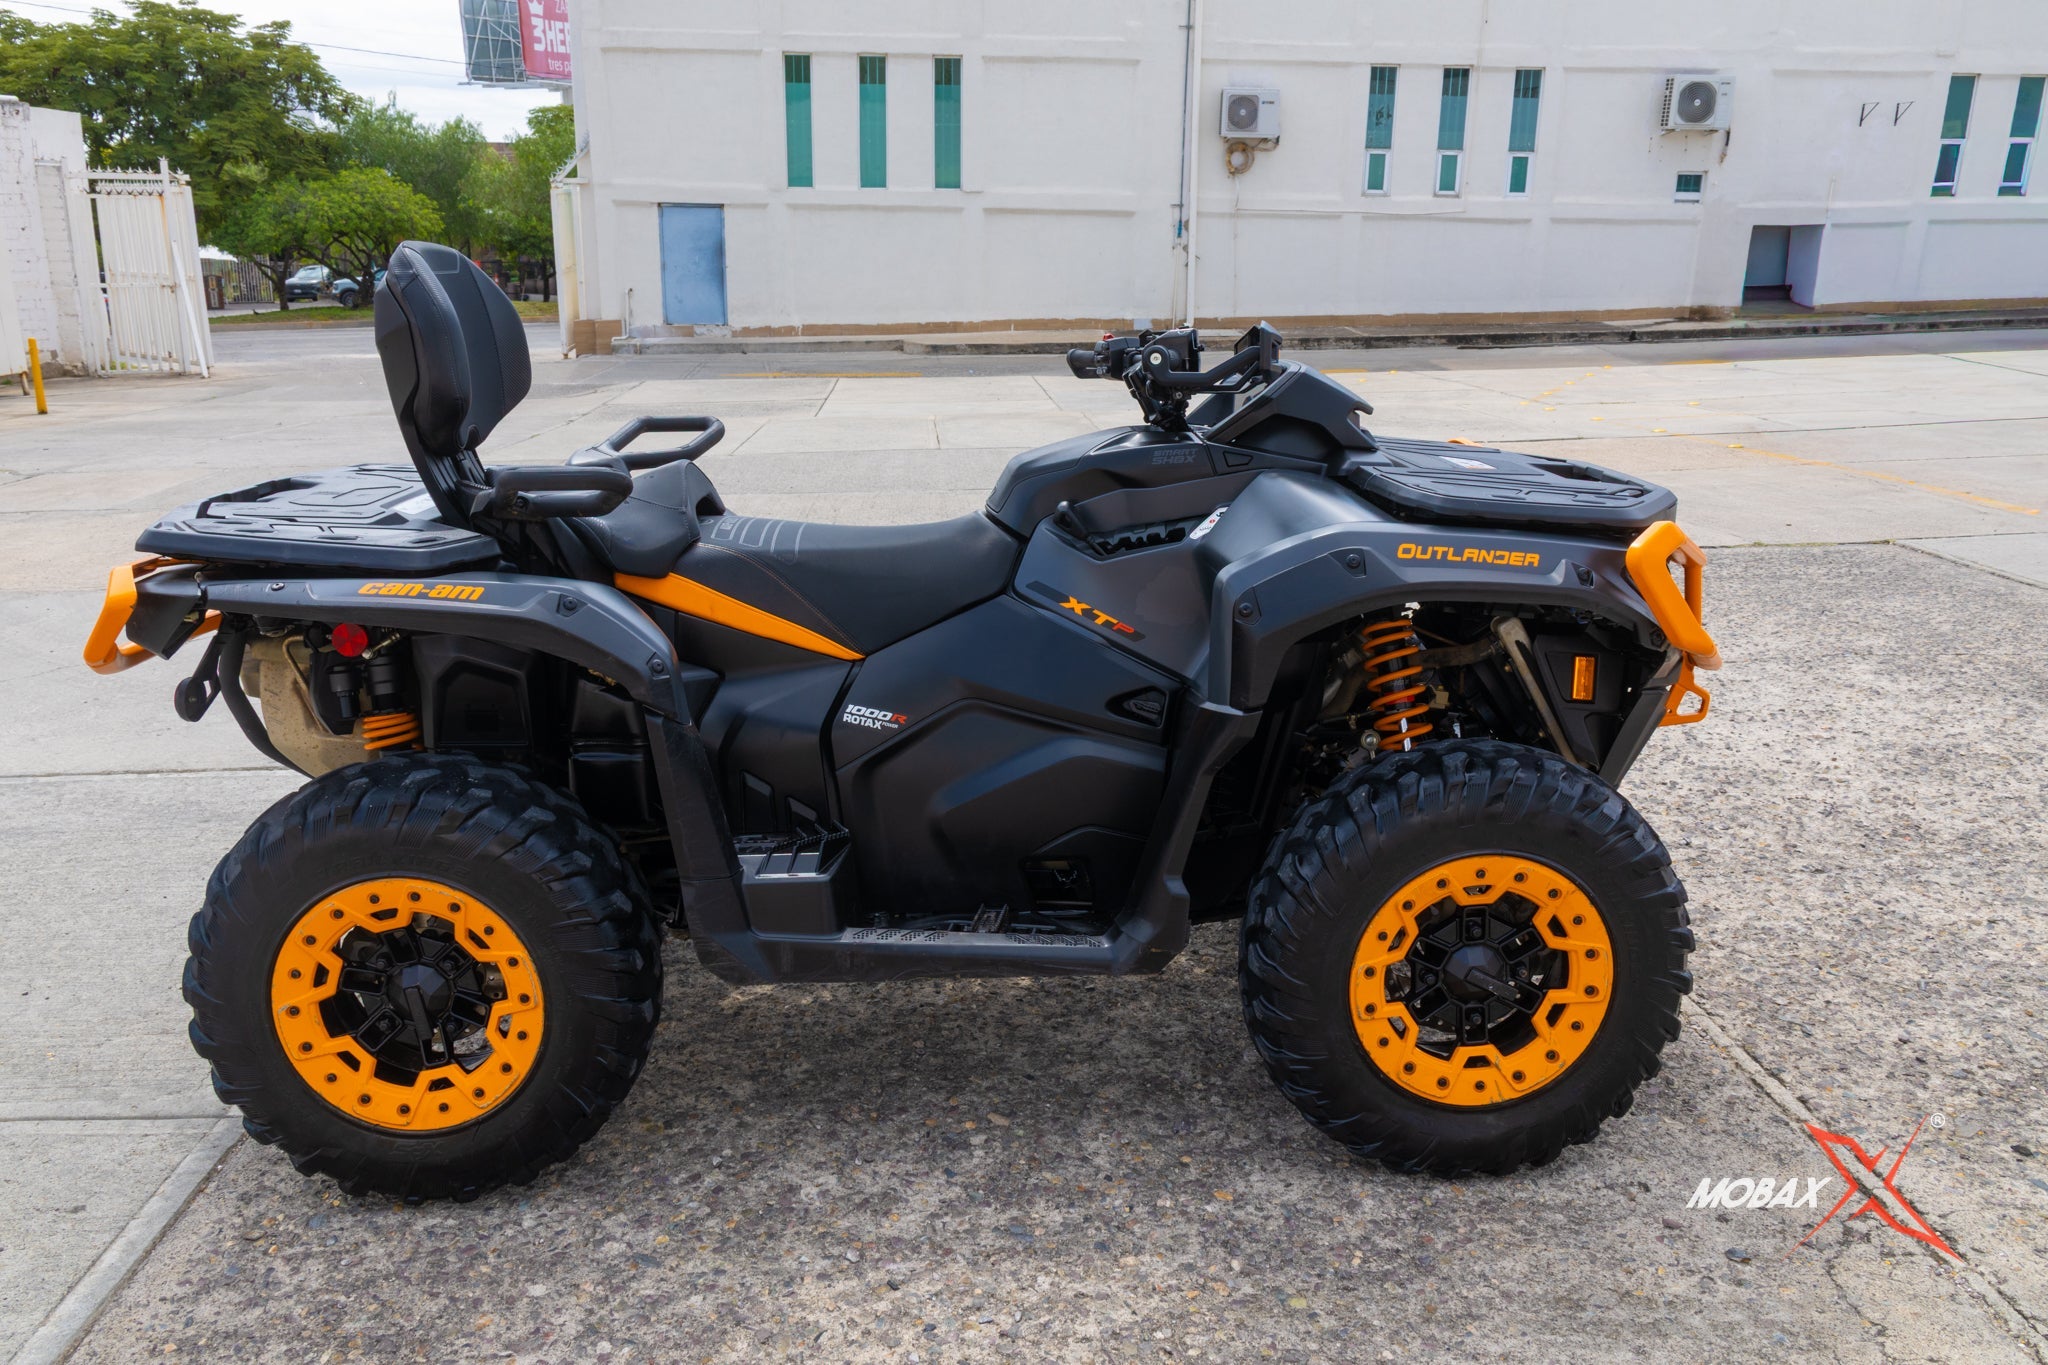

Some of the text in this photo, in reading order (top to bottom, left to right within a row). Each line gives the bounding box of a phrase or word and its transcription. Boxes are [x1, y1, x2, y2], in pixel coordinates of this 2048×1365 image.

[548, 57, 564, 71] tres
[358, 582, 485, 600] can-am
[843, 713, 899, 730] ROTAX POWER
